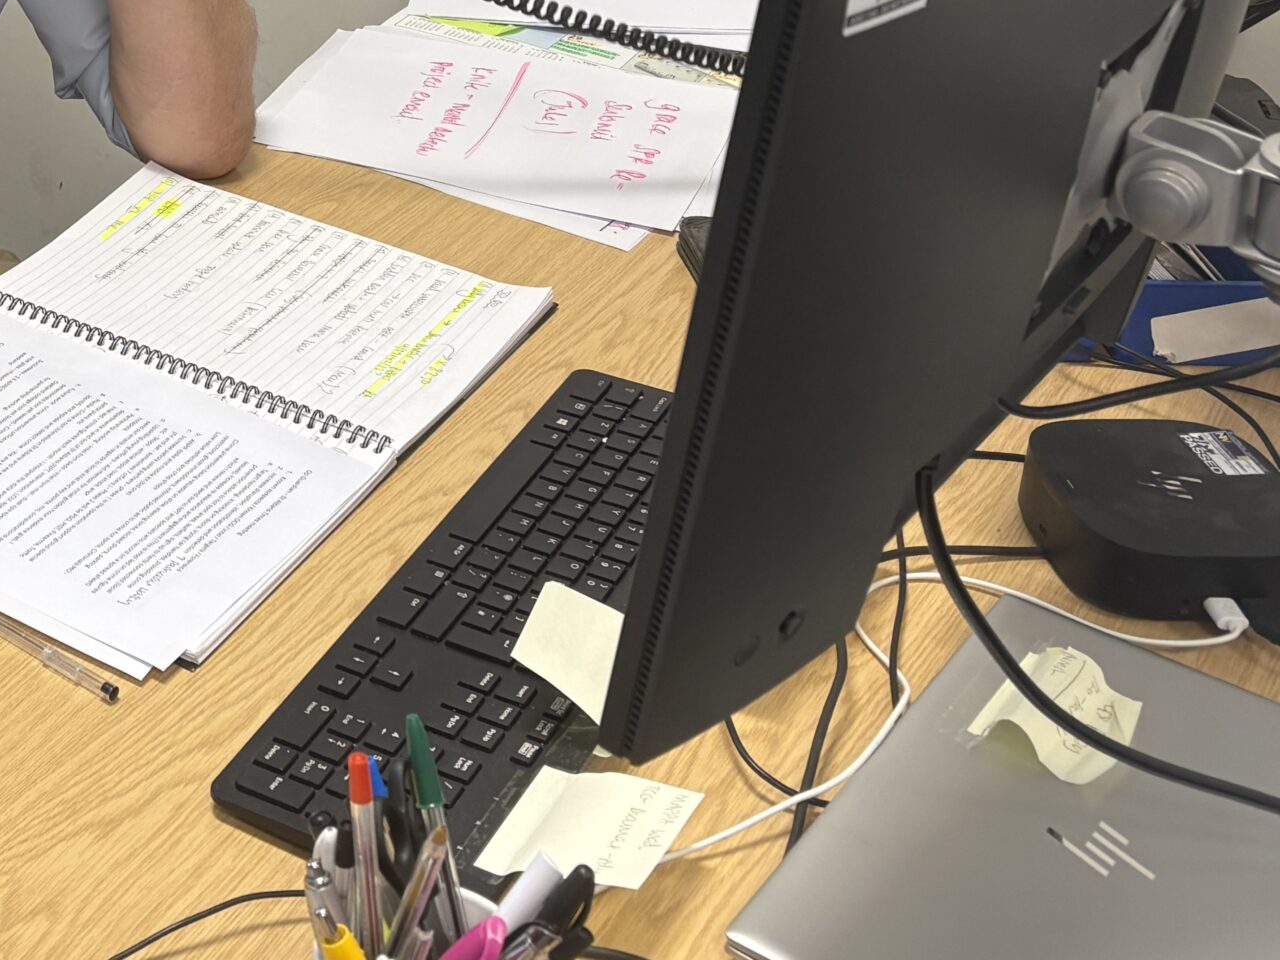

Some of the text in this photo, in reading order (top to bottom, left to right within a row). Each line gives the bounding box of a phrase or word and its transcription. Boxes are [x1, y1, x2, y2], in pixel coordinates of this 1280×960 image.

[1179, 435, 1223, 474] PASSED
[479, 672, 494, 686] Delete
[516, 685, 529, 698] Insert
[466, 693, 477, 704] End
[342, 713, 354, 725] End
[499, 706, 513, 720] Home
[453, 756, 467, 769] Lock
[461, 759, 474, 772] Num
[269, 776, 283, 791] Enter
